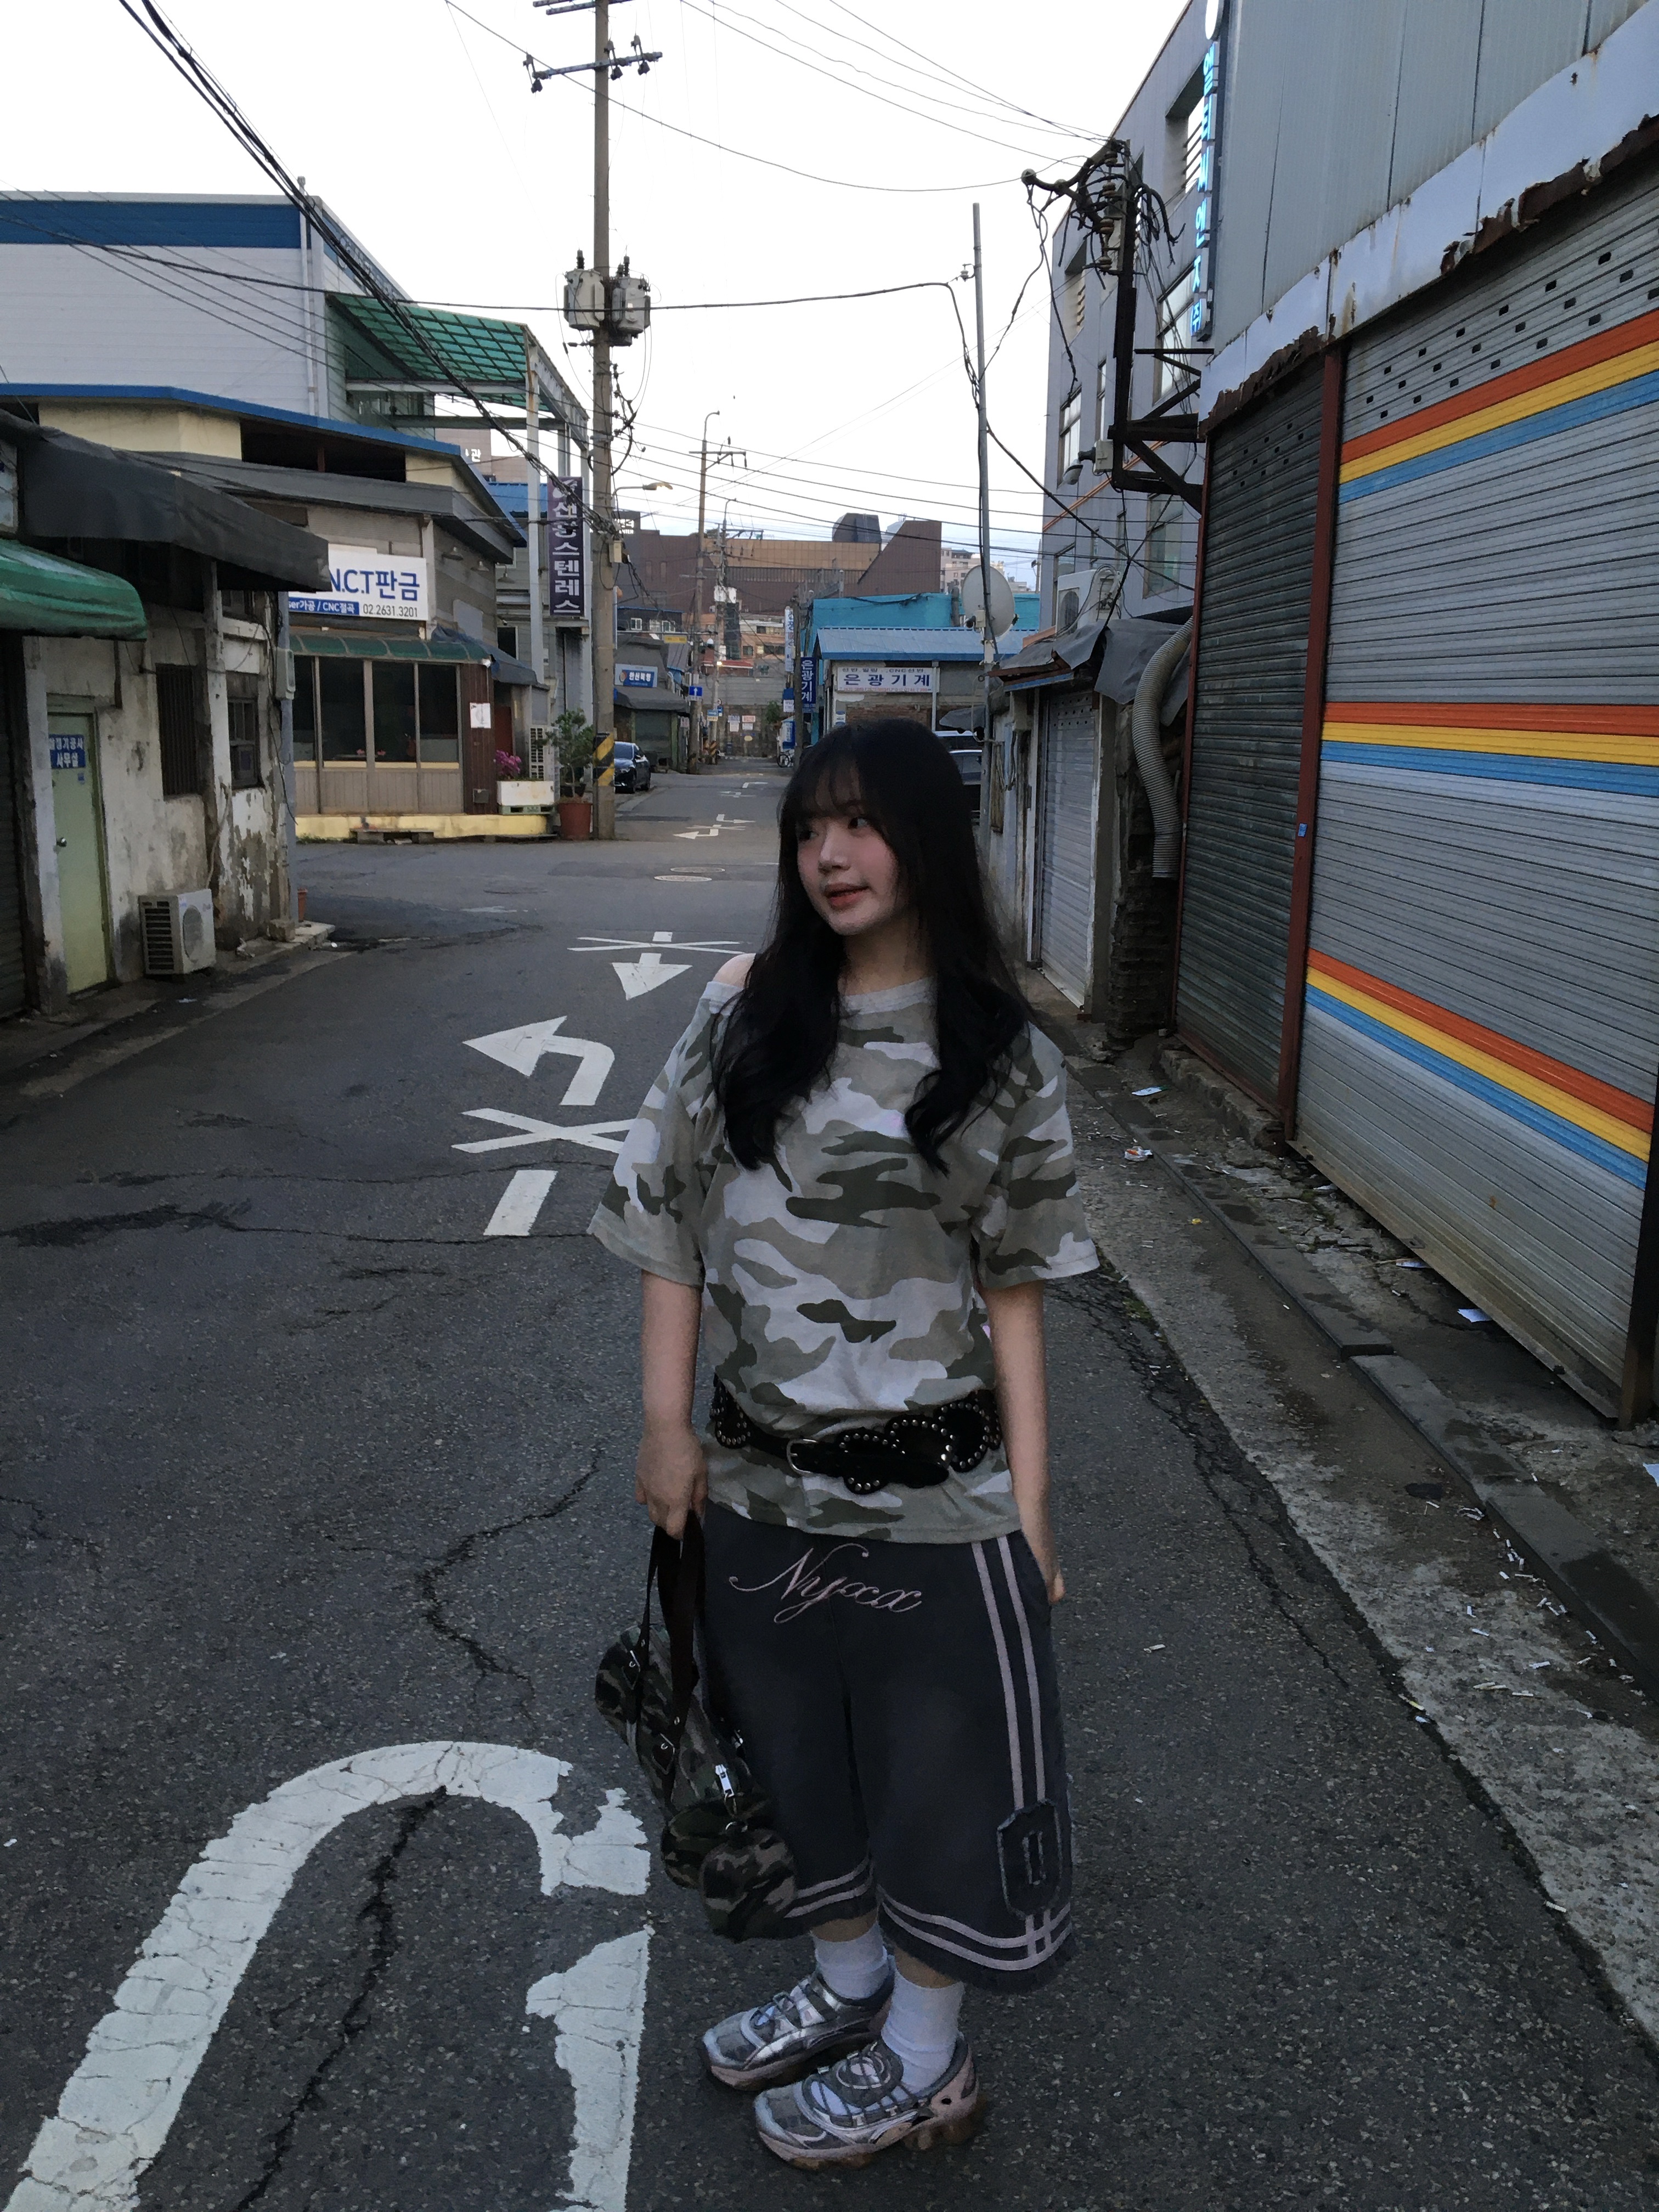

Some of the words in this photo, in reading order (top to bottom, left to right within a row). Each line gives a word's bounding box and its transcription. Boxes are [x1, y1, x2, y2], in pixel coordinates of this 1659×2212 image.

[363, 603, 417, 617] 02.2631.3201
[801, 659, 814, 702] 은광기계
[843, 674, 930, 687] 은광기계
[57, 752, 78, 768] 사무실
